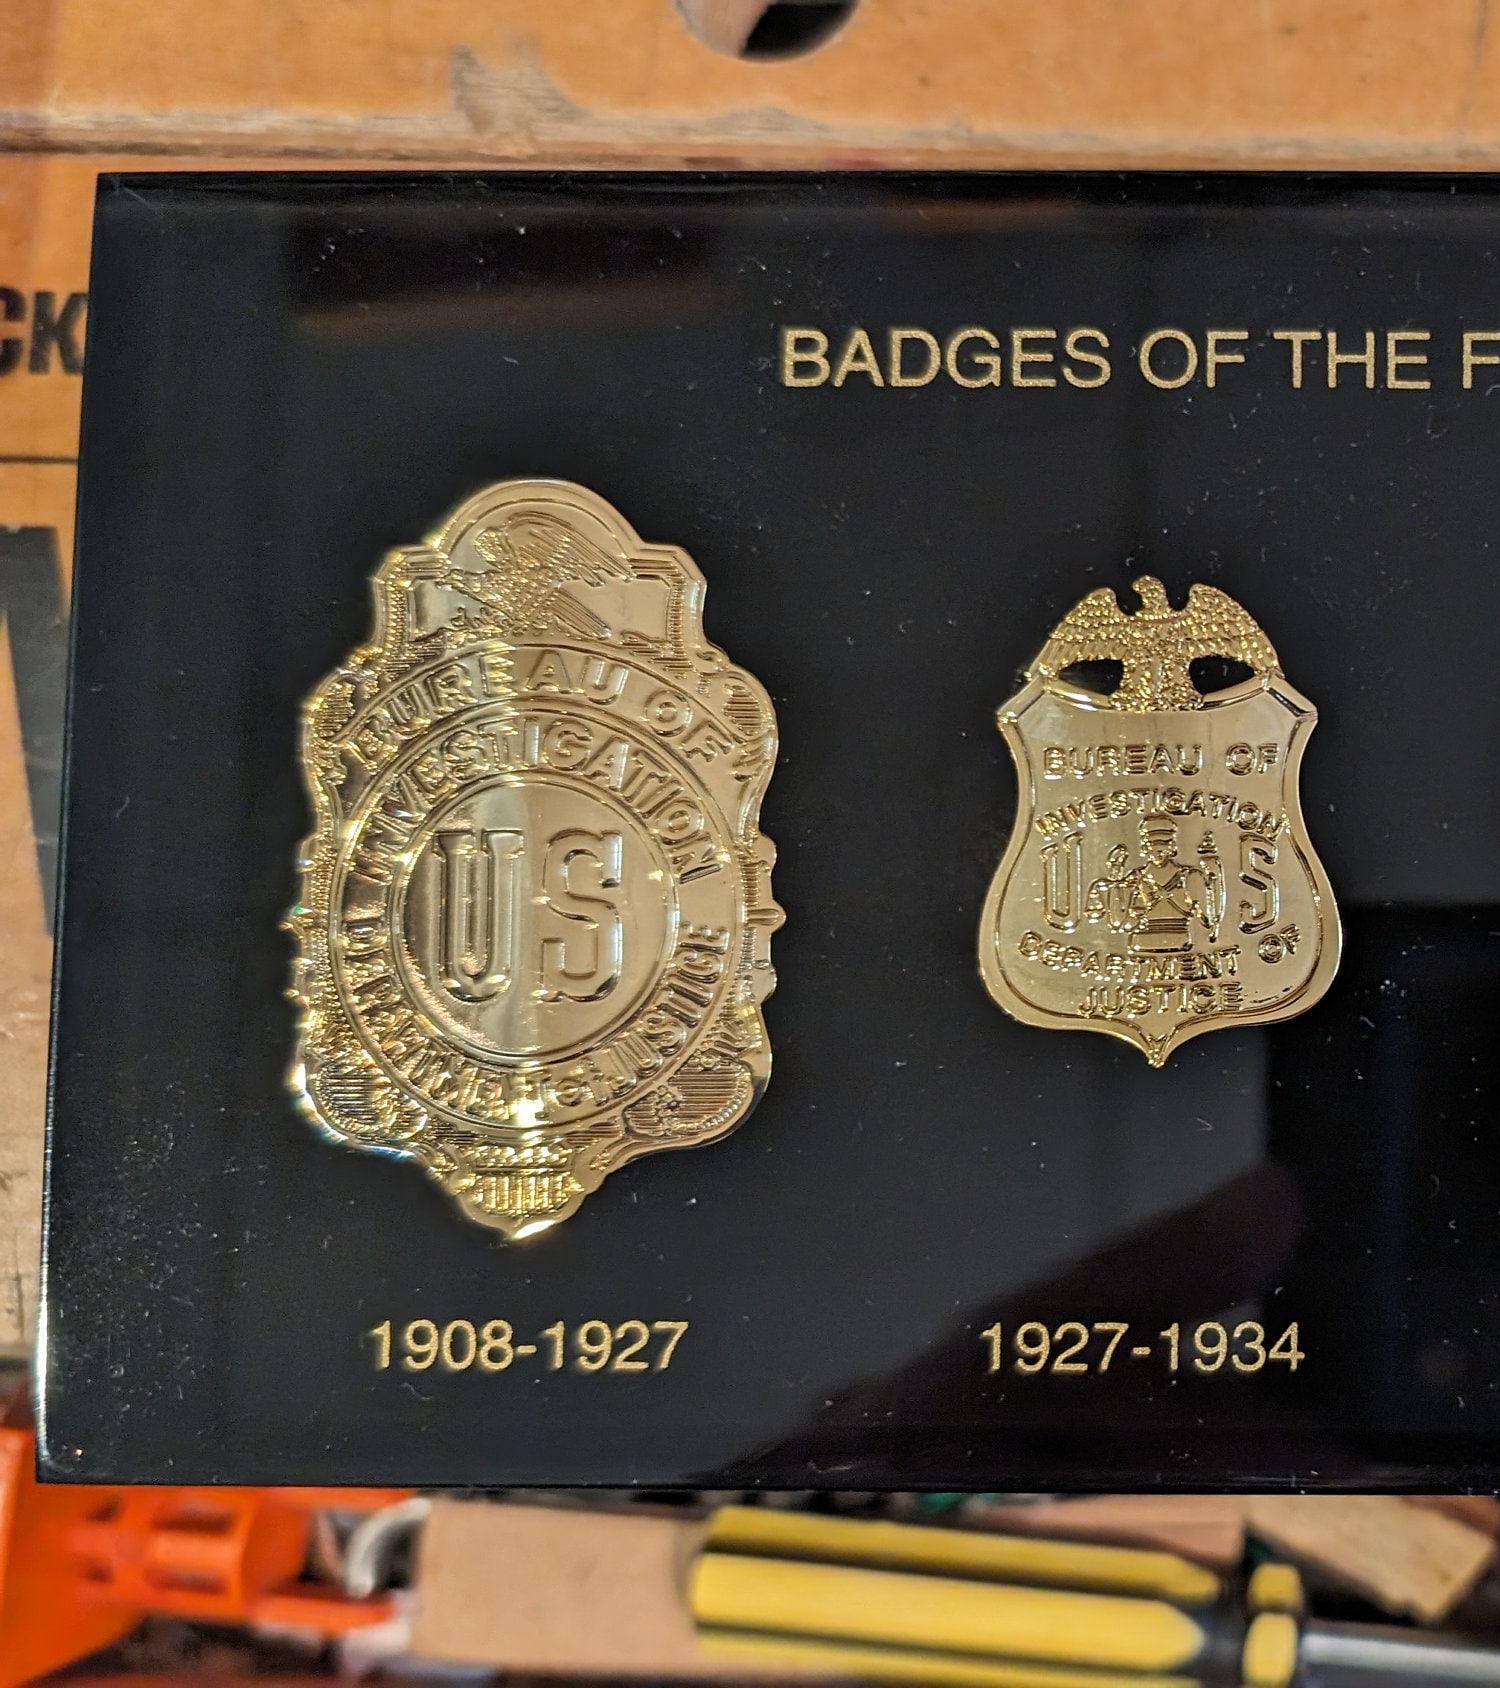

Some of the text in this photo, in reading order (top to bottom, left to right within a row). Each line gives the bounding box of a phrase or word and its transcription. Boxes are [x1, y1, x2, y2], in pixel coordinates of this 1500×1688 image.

[780, 328, 1112, 388] BADGES
[1138, 328, 1250, 389] OF
[1273, 330, 1431, 390] THE
[360, 648, 735, 769] BUREAU OF
[1042, 742, 1280, 780] BUREAU OF
[352, 715, 726, 887] INVESTIGATION
[1034, 787, 1291, 841] INVESTIGATION
[1018, 923, 1301, 983] DEPARTMENT OF
[1076, 981, 1244, 1020] JUSTICE
[371, 1318, 690, 1374] 1908-1927
[980, 1320, 1306, 1374] 1927-1934
